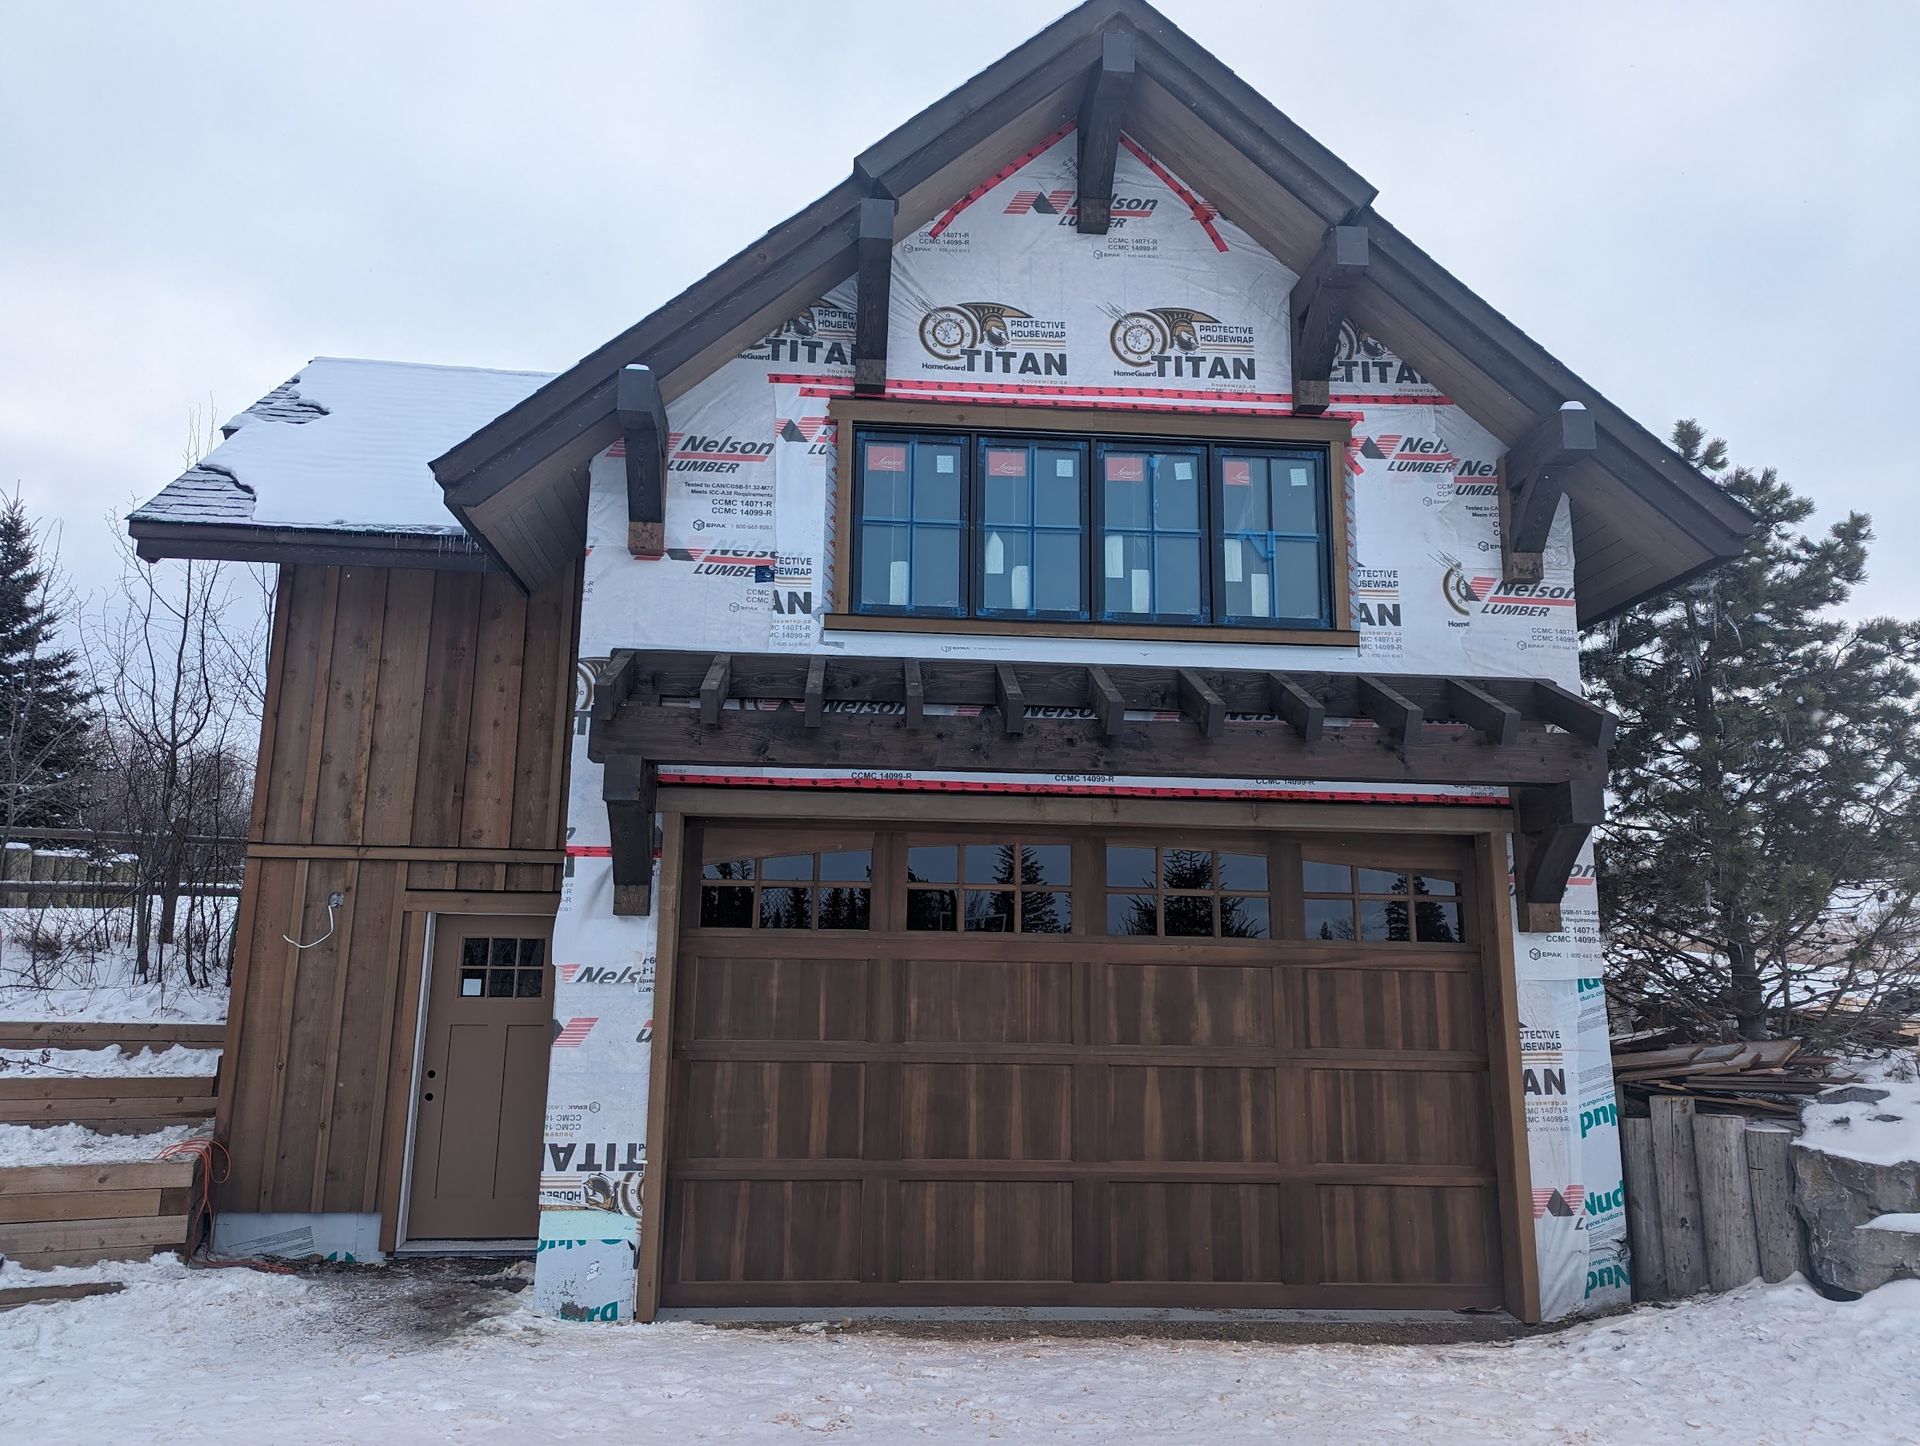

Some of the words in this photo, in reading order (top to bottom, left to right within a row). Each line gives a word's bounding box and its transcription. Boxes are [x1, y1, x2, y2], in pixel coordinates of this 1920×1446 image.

[1058, 216, 1127, 228] LUER
[818, 309, 857, 320] PROTEC
[1011, 319, 1066, 329] PROTECTIVE
[1200, 325, 1254, 334] PROTECTIVE
[1011, 330, 1066, 339] HOUSEWRAP
[1200, 335, 1254, 344] HOUSEWRAP
[765, 338, 857, 366] TITA
[922, 363, 966, 371] HomeGuard
[960, 349, 1067, 376] TITAN
[1151, 355, 1256, 380] TITAN
[1338, 361, 1429, 384] TITA
[680, 435, 775, 455] Nelson
[667, 460, 740, 474] LUMBER
[740, 500, 772, 508] 14071-R
[693, 564, 756, 578] LUMBE
[1481, 604, 1550, 617] LUMBER
[851, 772, 877, 780] CCMC
[880, 772, 912, 781] 14099-R
[1054, 774, 1080, 782] CCMC
[1083, 775, 1115, 783] 14099-R
[543, 1143, 644, 1171] TITA
